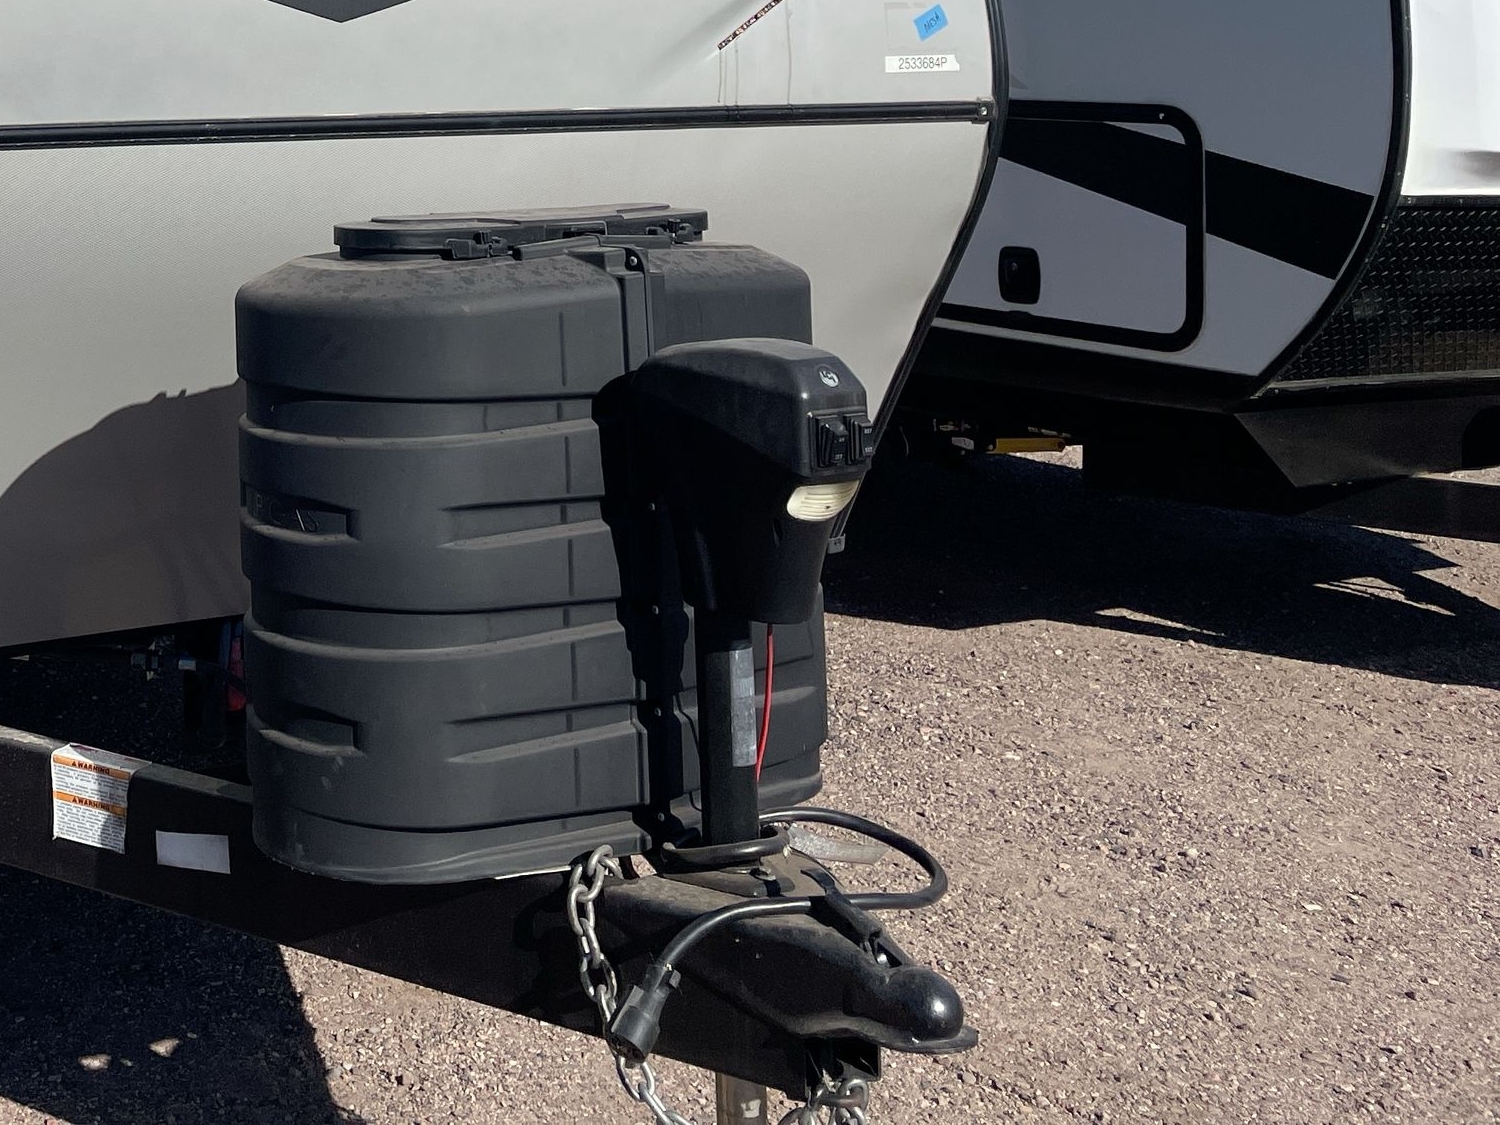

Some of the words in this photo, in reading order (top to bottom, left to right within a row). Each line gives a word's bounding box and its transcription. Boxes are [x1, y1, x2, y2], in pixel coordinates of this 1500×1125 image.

[898, 56, 948, 70] 2533684P
[78, 761, 110, 776] WARNING
[78, 797, 110, 812] WARNING
